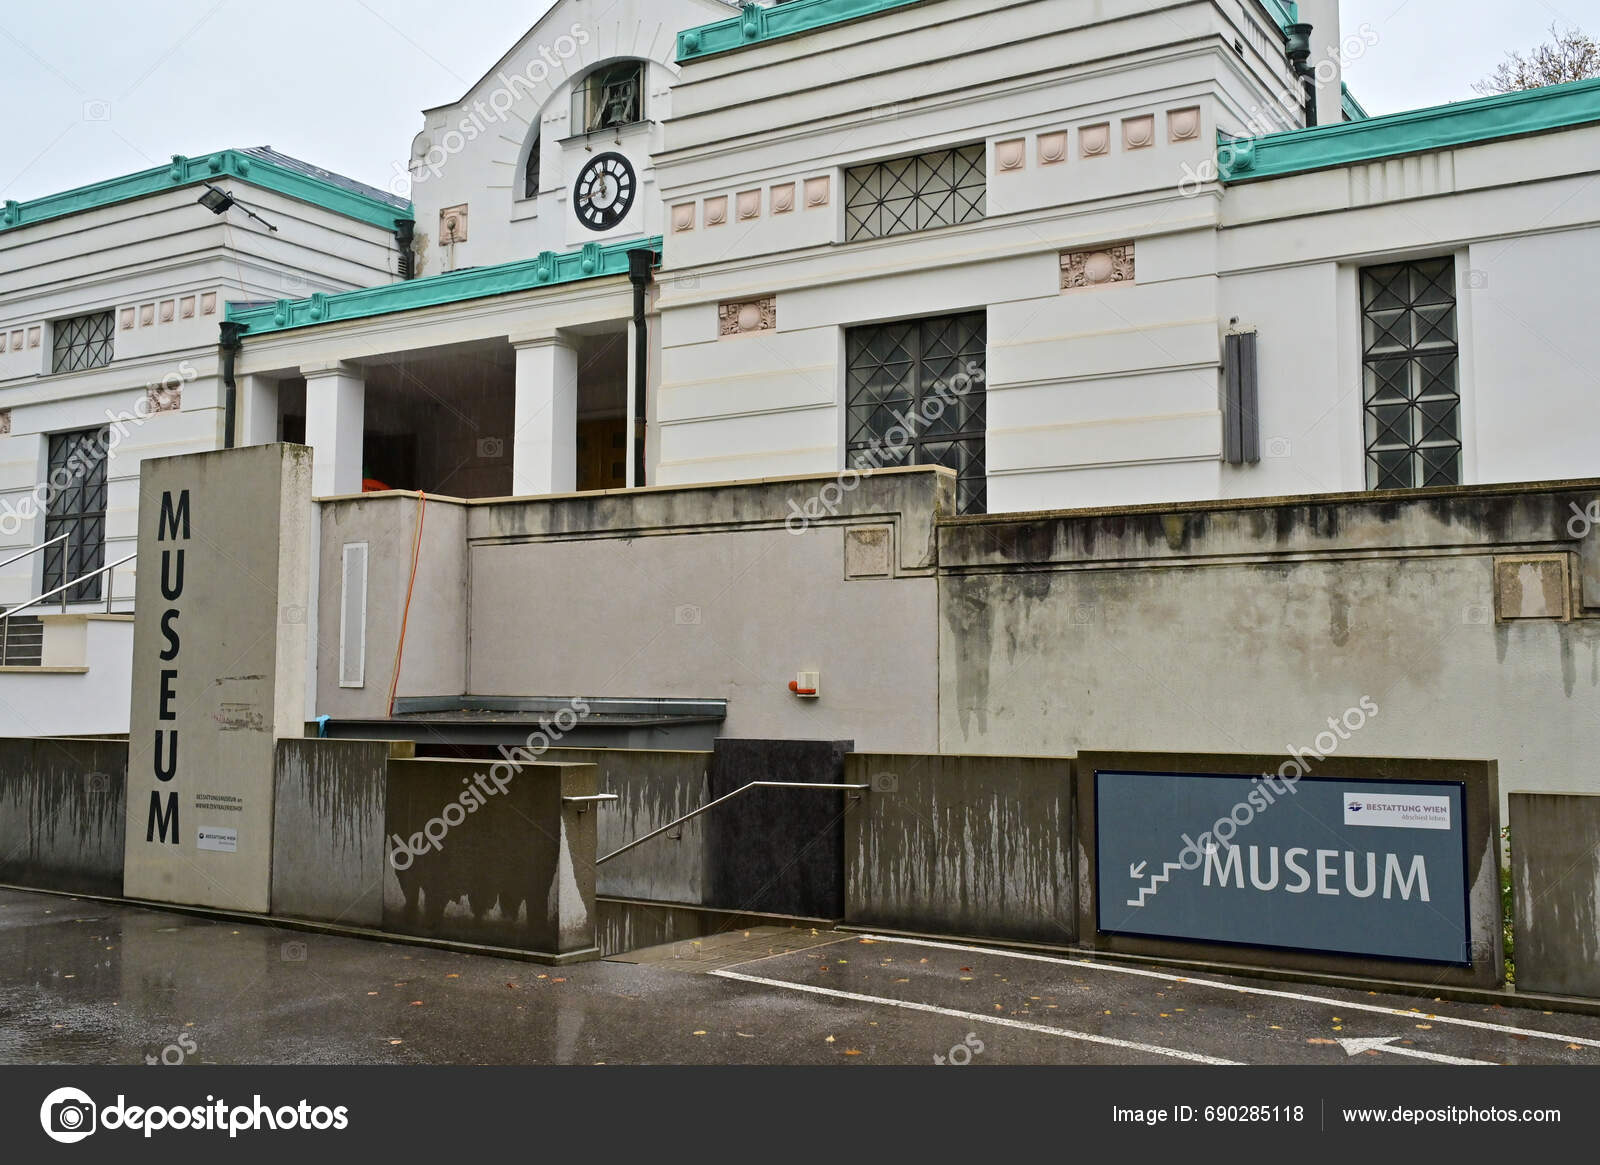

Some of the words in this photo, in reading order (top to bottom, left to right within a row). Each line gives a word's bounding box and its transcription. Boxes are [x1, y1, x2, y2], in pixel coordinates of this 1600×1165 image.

[147, 489, 191, 844] MUSEUM
[1366, 803, 1421, 813] BESTATTUNG
[1423, 806, 1447, 814] WIEN
[1203, 843, 1430, 902] MUSEUM
